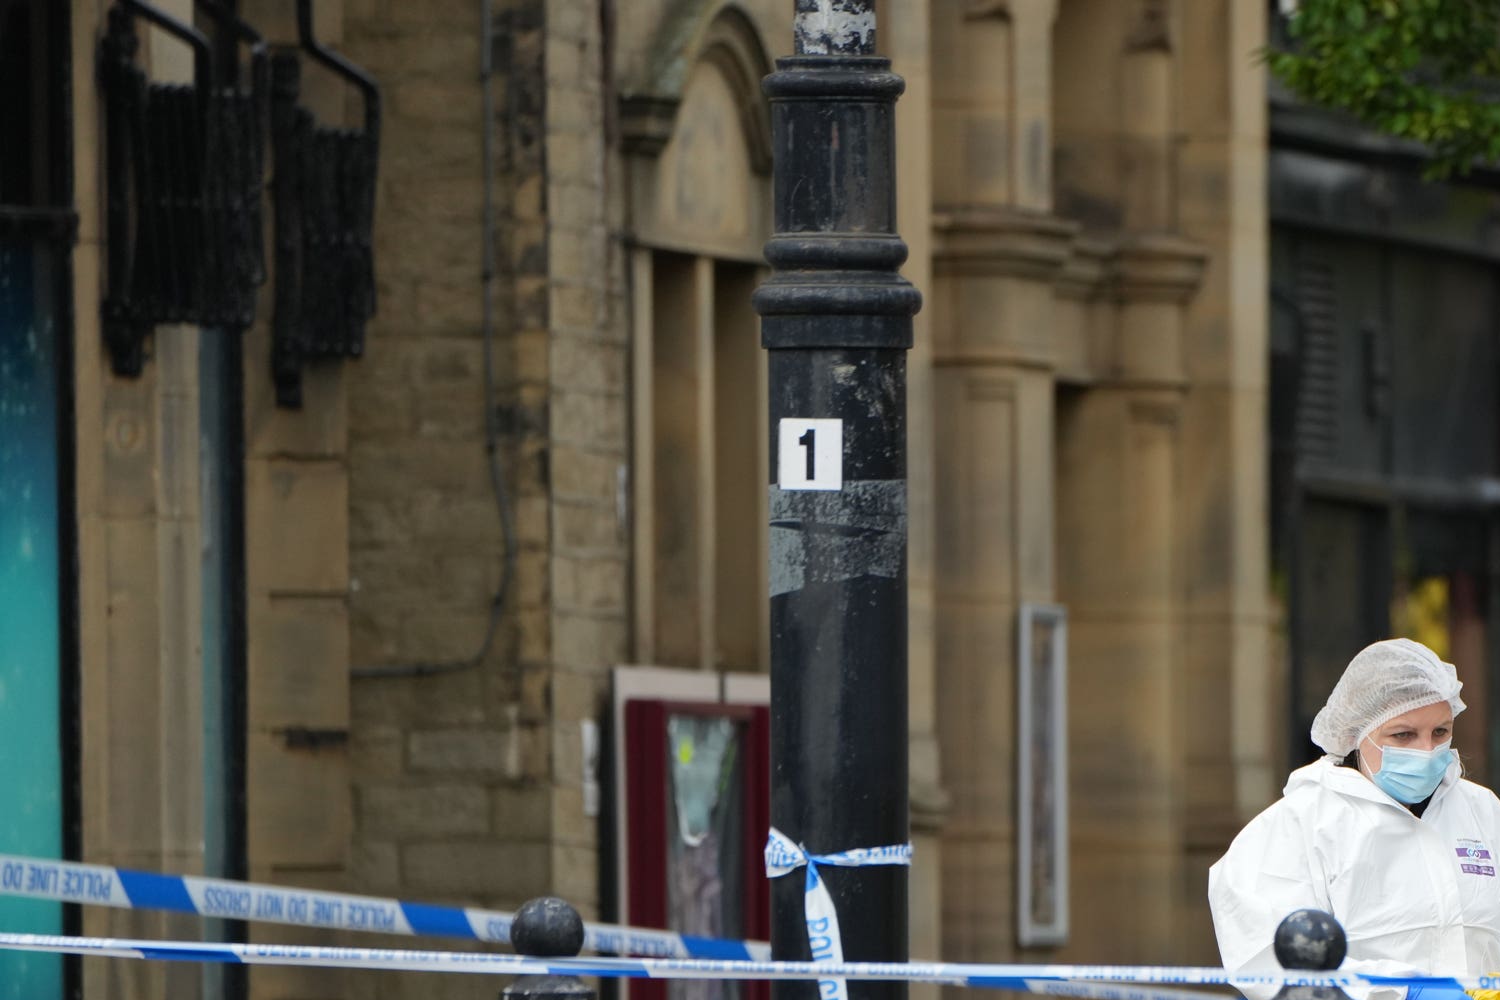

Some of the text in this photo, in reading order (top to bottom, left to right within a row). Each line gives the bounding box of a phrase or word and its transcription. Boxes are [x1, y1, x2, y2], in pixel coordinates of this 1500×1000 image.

[799, 429, 815, 480] 1
[2, 860, 112, 898] POLICE LINE DO
[203, 885, 396, 932] POLICE LINE DO NOT CROSS
